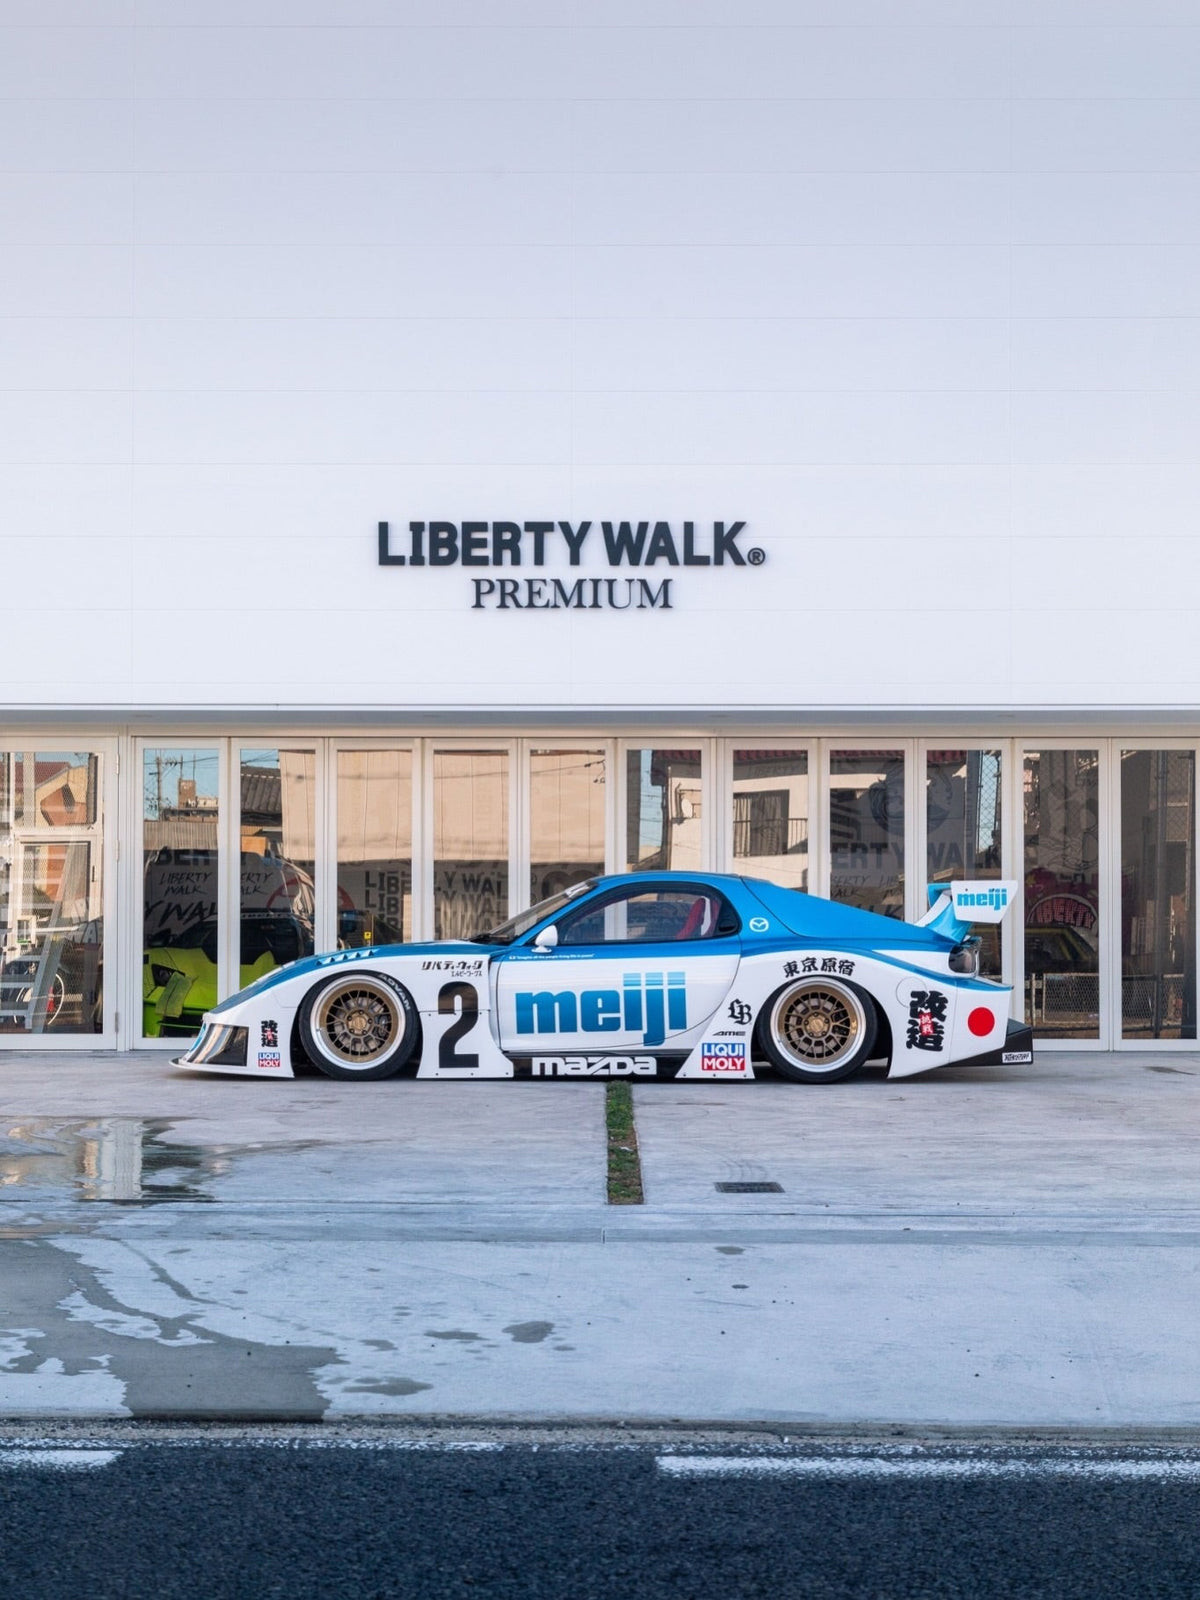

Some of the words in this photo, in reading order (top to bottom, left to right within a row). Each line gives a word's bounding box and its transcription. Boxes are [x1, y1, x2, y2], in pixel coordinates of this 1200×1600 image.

[378, 521, 592, 566] LIBERTY
[471, 578, 673, 608] PREMIUM
[957, 888, 1007, 910] meiji
[783, 956, 855, 978] 東京原宿
[515, 971, 687, 1046] meiji
[906, 990, 948, 1052] 改造
[438, 981, 479, 1068] 2
[704, 1044, 744, 1057] LIQUI
[704, 1058, 744, 1070] MOLY
